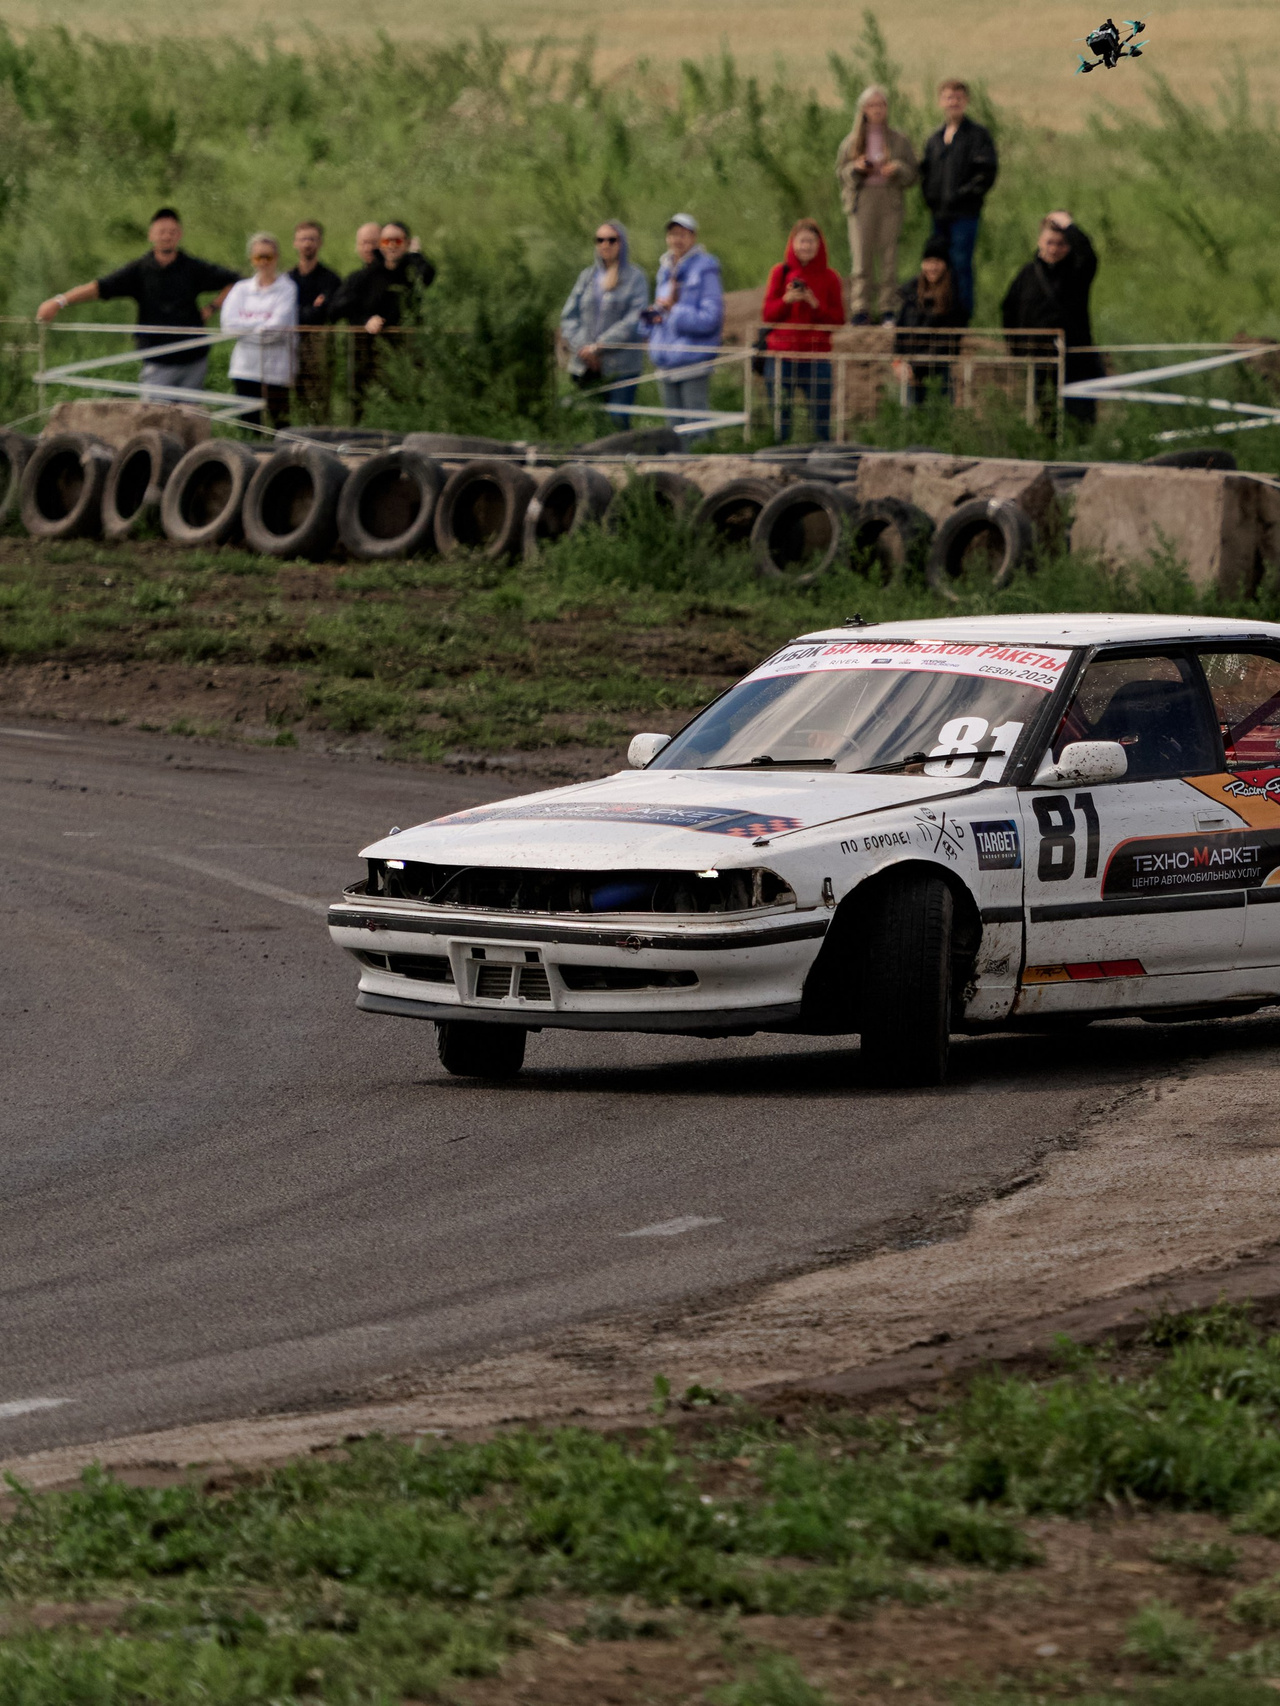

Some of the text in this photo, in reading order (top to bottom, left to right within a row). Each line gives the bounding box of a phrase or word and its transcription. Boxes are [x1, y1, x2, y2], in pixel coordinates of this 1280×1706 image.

[764, 645, 828, 668] КУБОК
[979, 665, 1058, 685] СЕЗОН 2025
[924, 717, 1024, 783] 81
[1223, 778, 1268, 800] Racing
[840, 831, 912, 855] ПО БОРОДЕ!
[976, 831, 1016, 853] TARGET
[1032, 792, 1101, 881] 81
[1132, 845, 1261, 872] ТЕХНО-МАРКЕТ
[1131, 864, 1262, 888] ЦЕНТР АВТОМОБИЛЬНЫХ УСЛУГ
